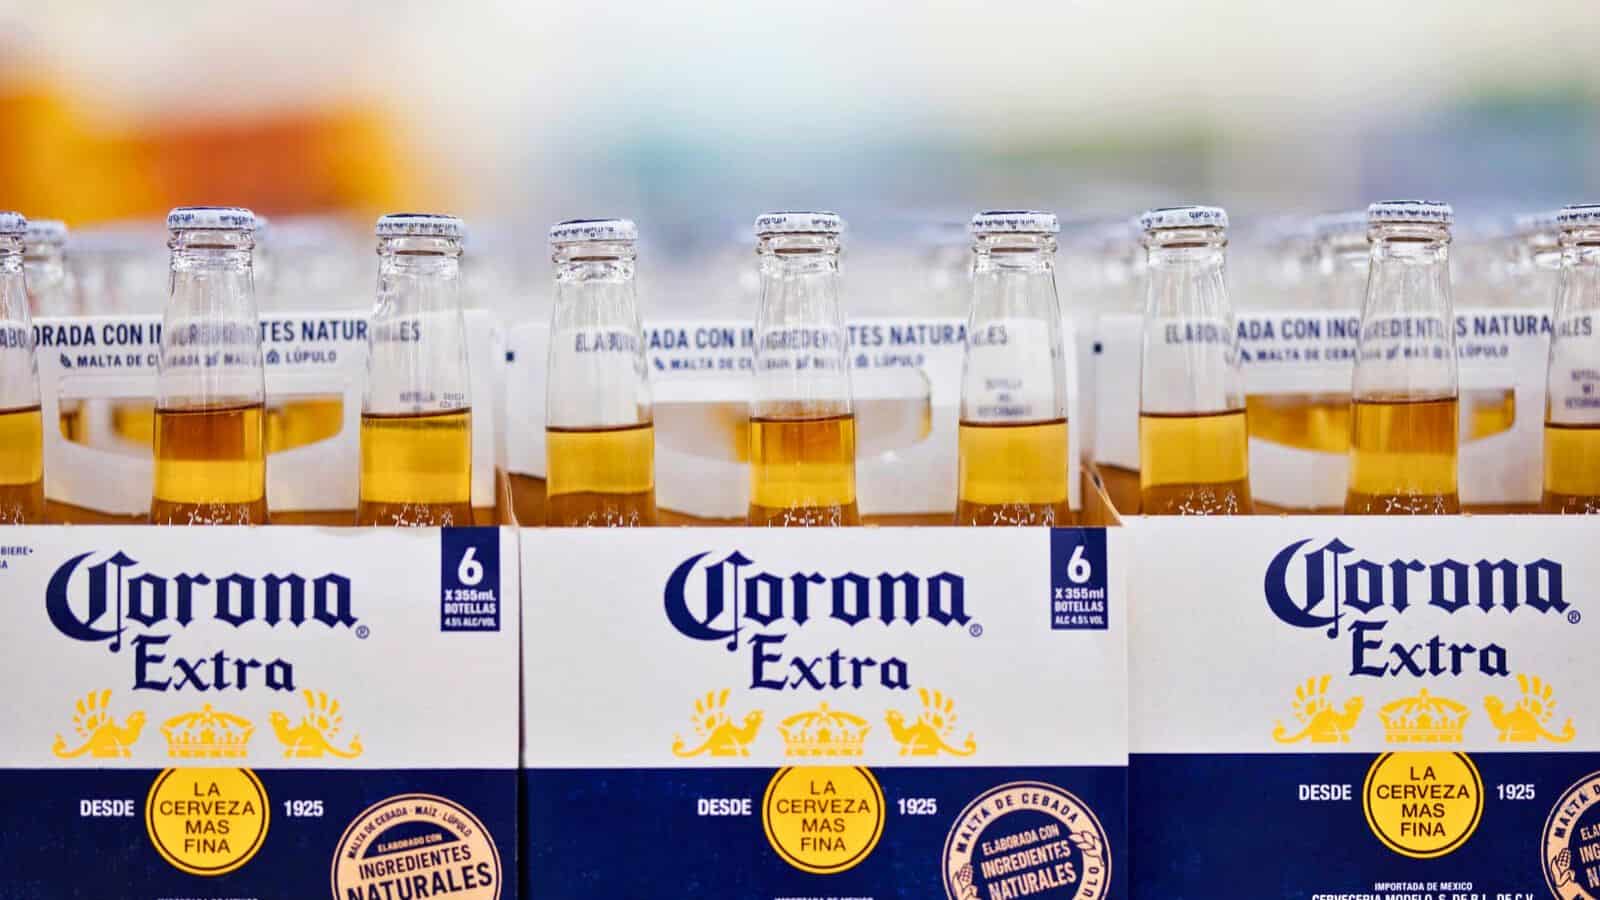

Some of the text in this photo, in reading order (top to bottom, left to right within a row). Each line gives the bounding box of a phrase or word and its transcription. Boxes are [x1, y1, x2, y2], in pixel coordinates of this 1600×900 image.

[103, 323, 143, 346] CON
[302, 319, 420, 342] NATURES
[1282, 319, 1320, 340] CON
[695, 328, 734, 349] CON
[77, 354, 121, 367] MALTA
[127, 354, 142, 367] DE
[458, 546, 484, 586] 6
[1067, 545, 1092, 584] 6
[445, 589, 453, 601] X
[1055, 588, 1104, 599] X 355ml
[1264, 537, 1571, 640] Corona
[45, 550, 358, 652] Corona
[444, 602, 496, 614] BOTELLAS
[664, 549, 972, 652] Corona
[1055, 601, 1104, 612] BOTELLAS
[1055, 615, 1070, 624] ALC
[1347, 620, 1511, 678] Extra
[131, 634, 296, 692] Extra
[748, 633, 911, 690] Extra
[1409, 766, 1436, 781] LA
[193, 782, 221, 797] LA
[810, 780, 836, 796] LA
[1298, 783, 1535, 801] DESDE 1925
[1376, 784, 1470, 800] CERVEZA
[80, 800, 324, 817] DESDE 1925
[159, 800, 256, 816] CERVEZA
[697, 799, 937, 816] DESDE 1925
[776, 799, 871, 815] CERVEZA
[1401, 803, 1445, 818] MAS
[1554, 792, 1590, 839] MALTA
[185, 819, 230, 835] MAS
[801, 817, 845, 833] MAS
[956, 792, 1079, 854] MALTA DE CEBADA
[1400, 822, 1446, 837] FINA
[185, 838, 231, 854] FINA
[800, 836, 847, 852] FINA
[981, 823, 1060, 856] ELABORADA CON
[359, 844, 472, 881] INGREDIENTES
[980, 839, 1072, 880] INGREDIENTES
[347, 862, 493, 900] NATURALES
[987, 861, 1077, 900] NATURALES
[1374, 882, 1473, 891] IMPORTADA DE MEXICO
